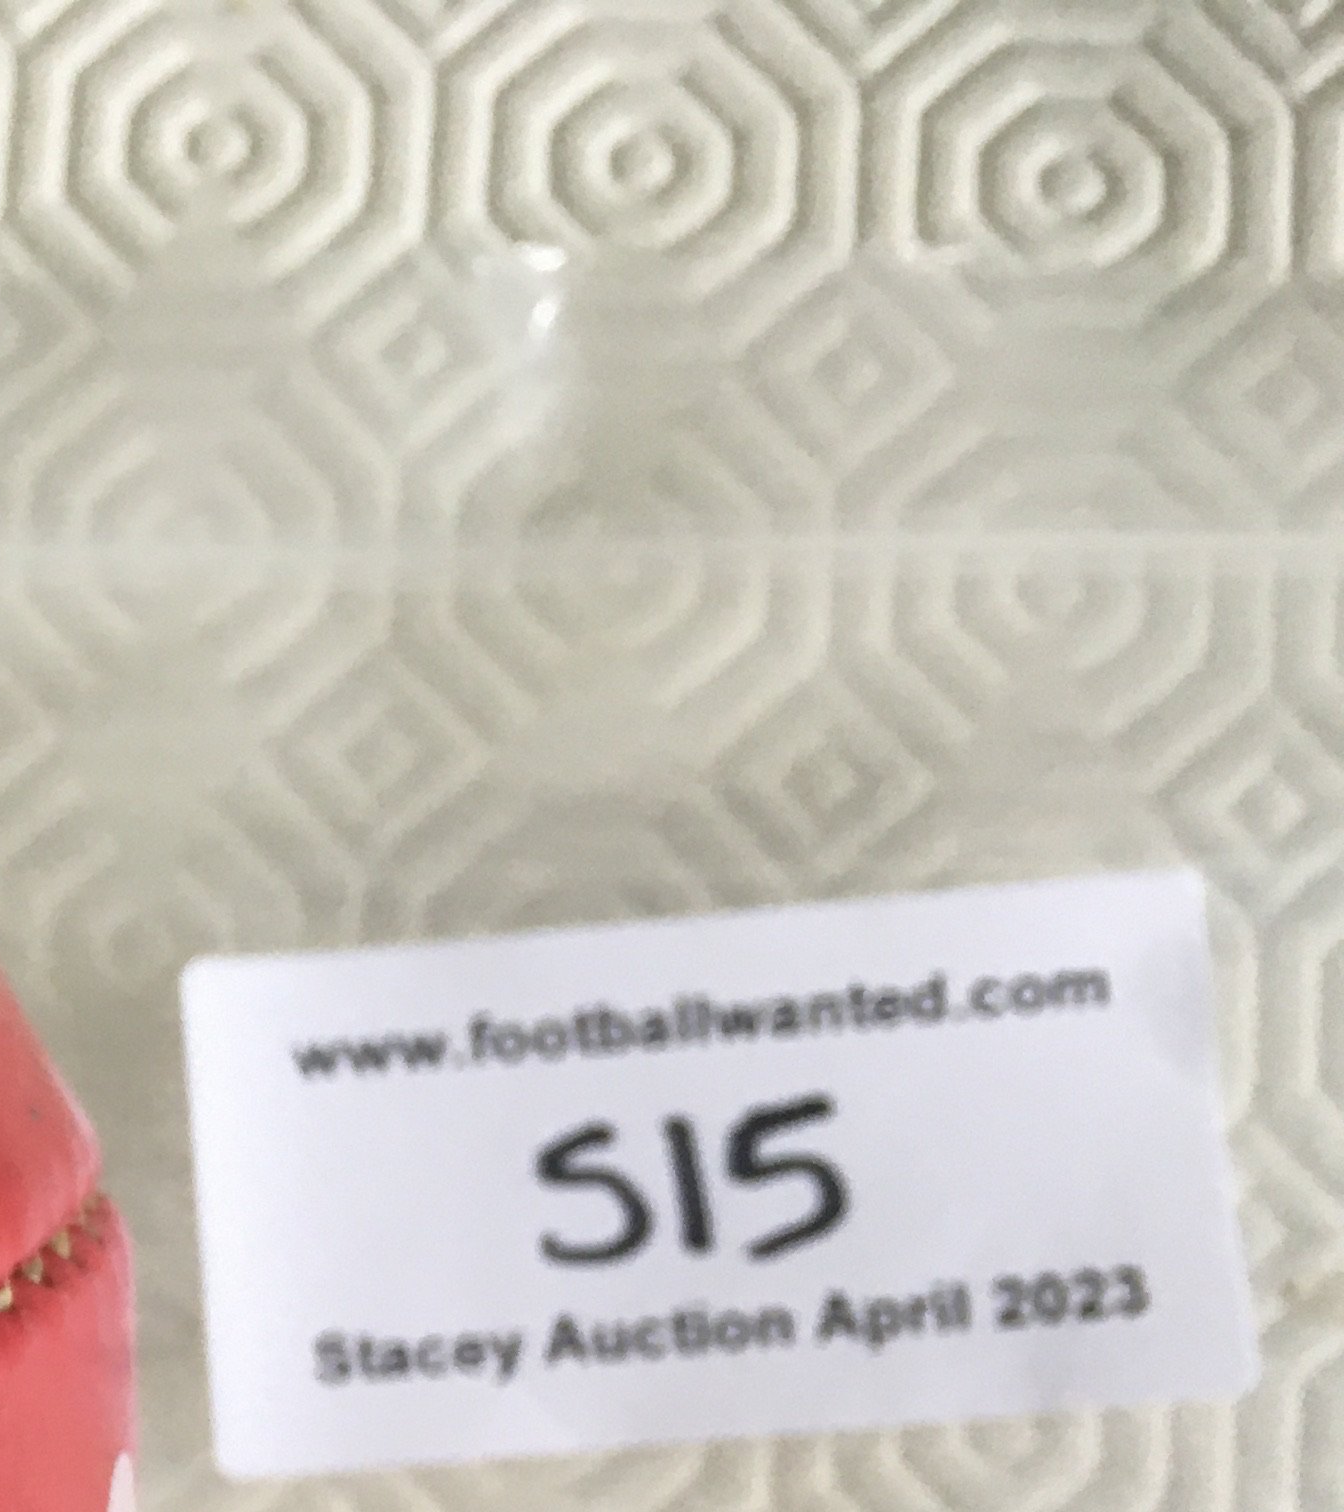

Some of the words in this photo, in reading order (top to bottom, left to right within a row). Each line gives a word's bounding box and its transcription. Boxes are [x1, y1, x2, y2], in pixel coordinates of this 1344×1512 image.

[290, 963, 1112, 1082] www.footballwanted.com
[311, 1323, 522, 1386] Stacey
[544, 1301, 795, 1366] Auction
[817, 1278, 973, 1353] April
[993, 1265, 1151, 1331] 2023
